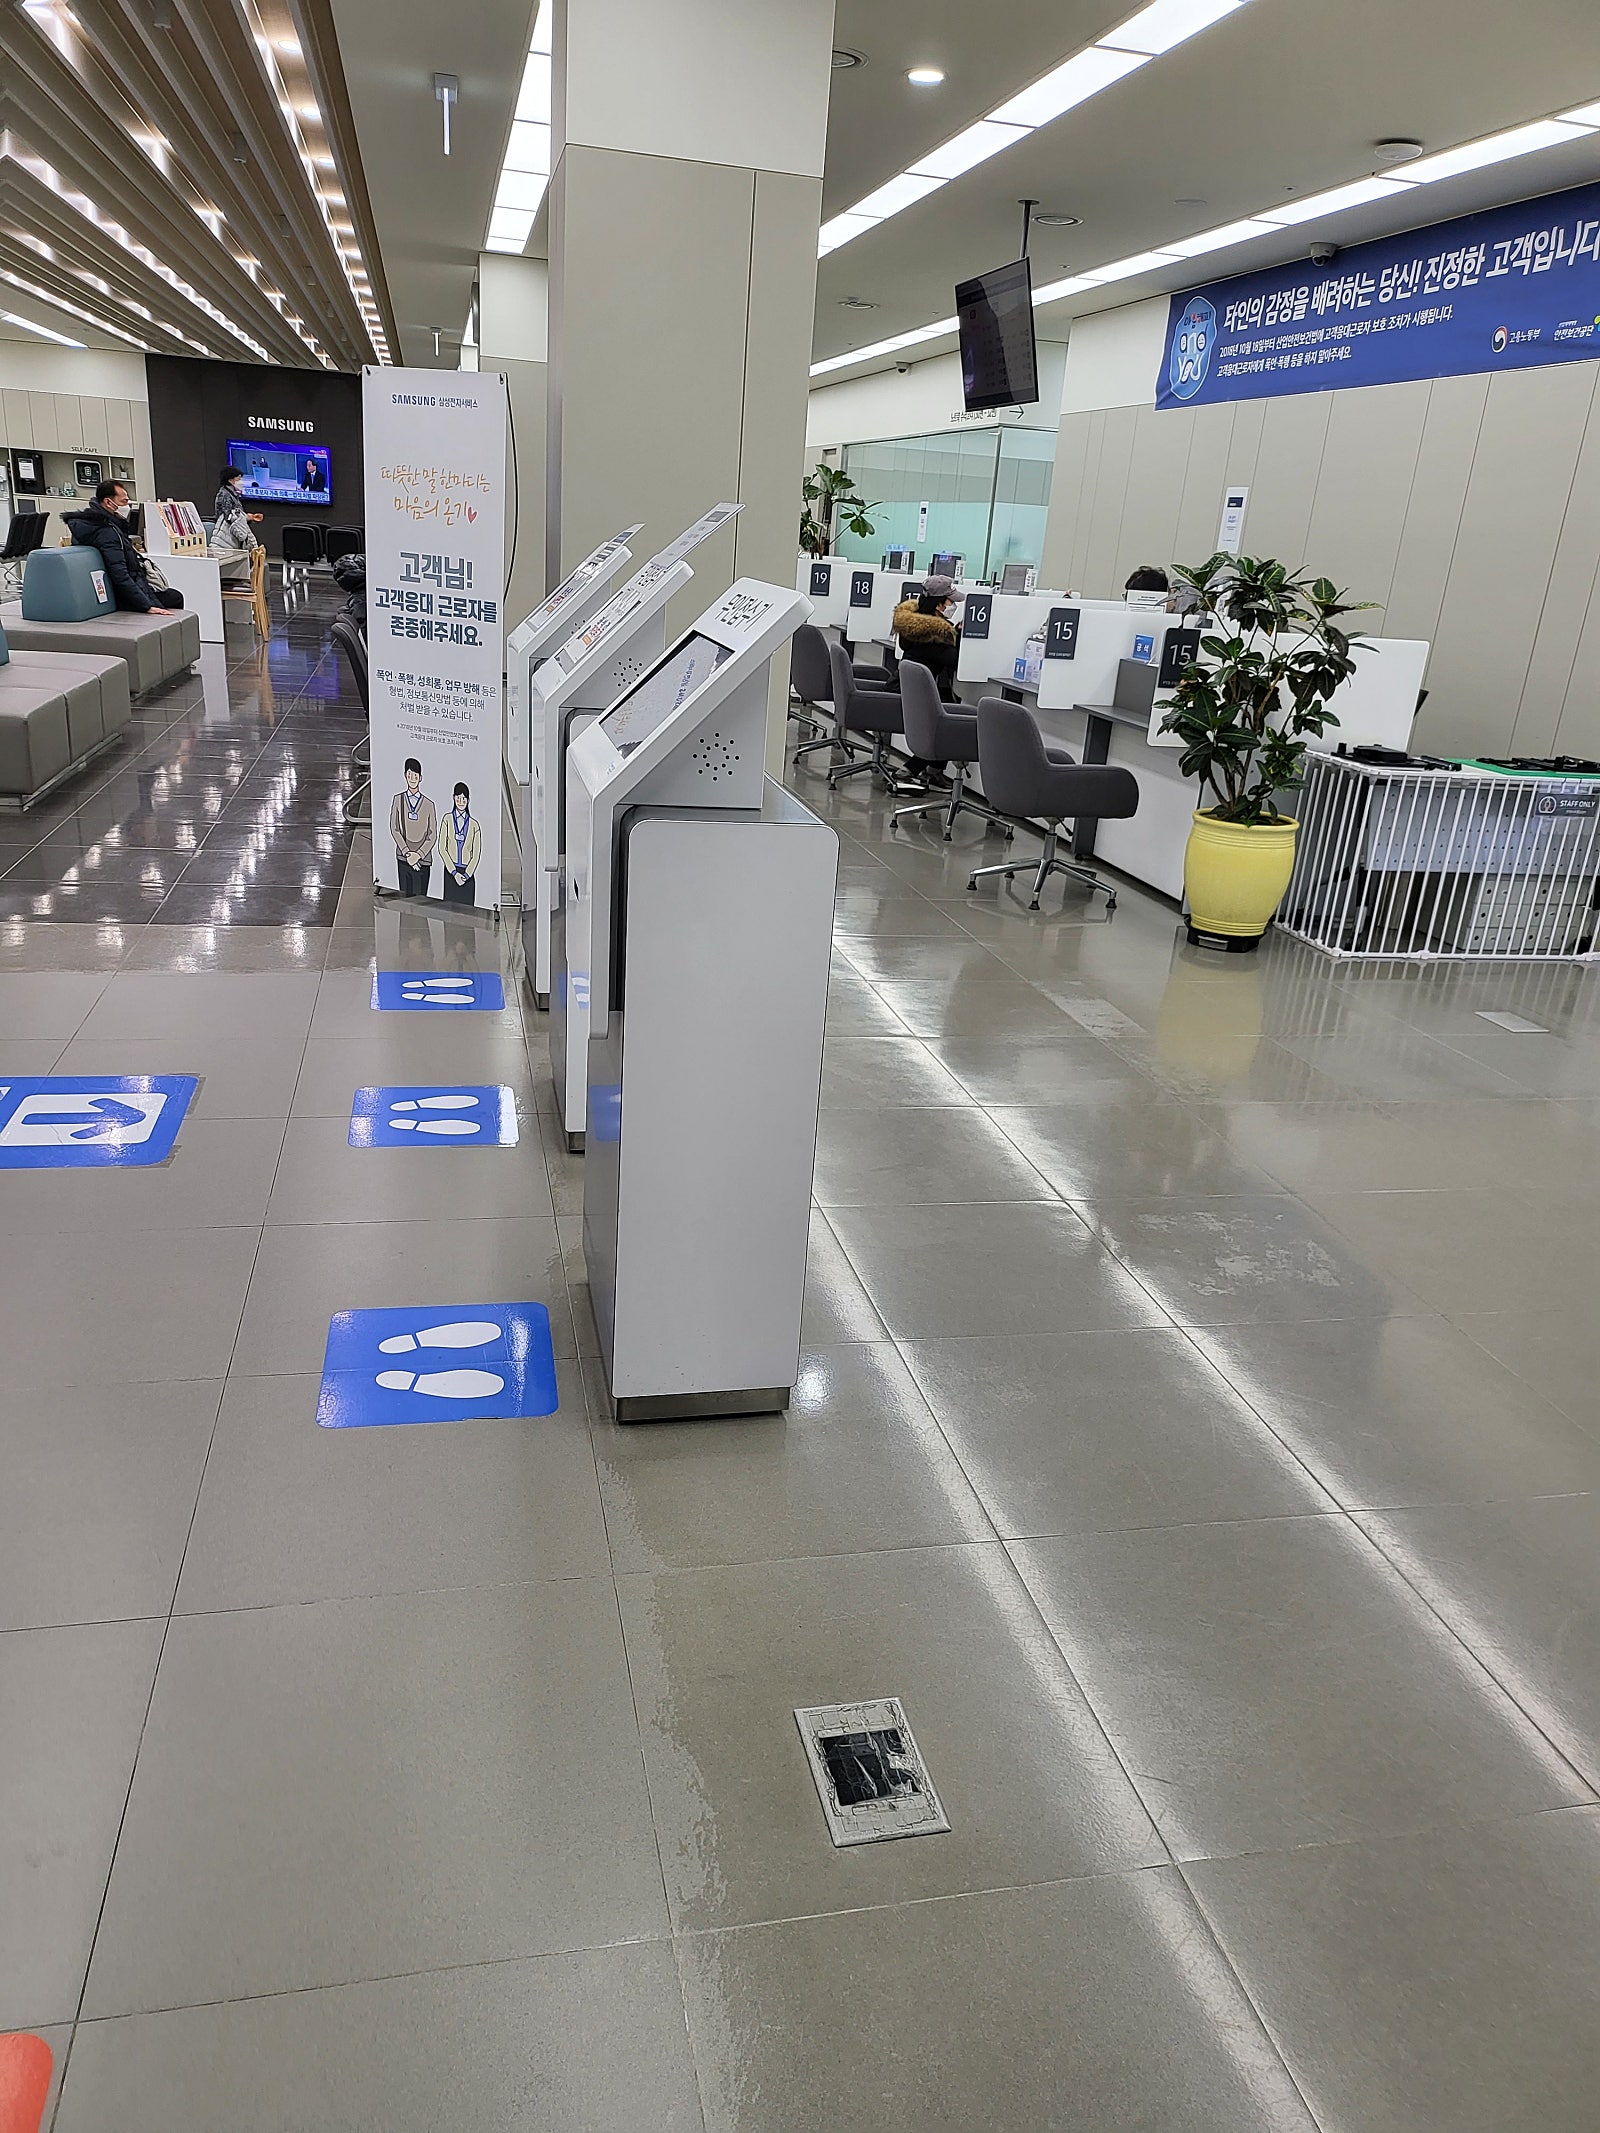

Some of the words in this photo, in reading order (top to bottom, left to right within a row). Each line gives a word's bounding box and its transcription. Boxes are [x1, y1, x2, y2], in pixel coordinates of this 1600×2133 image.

[1223, 294, 1266, 333] 타인의
[1265, 286, 1310, 326] 감정을
[1311, 272, 1376, 316] 배려하는
[1378, 259, 1423, 304] 당신!
[1423, 243, 1486, 295] 진정한
[1219, 343, 1239, 358] 2018년
[1239, 340, 1252, 355] 10월
[1252, 336, 1276, 354] 18일부터
[1323, 320, 1372, 340] 고객응대근로자
[1371, 318, 1387, 333] 보호
[1387, 312, 1412, 330] 조치가
[1412, 304, 1453, 327] 시행됩니다.
[1508, 328, 1541, 344] 고용노동부
[1553, 324, 1595, 341] 안전보건공단
[1216, 358, 1264, 377] 고객응대근로자에게
[1290, 352, 1304, 368] 등을
[1304, 350, 1317, 366] 하지
[391, 393, 436, 406] SAMSUNG
[438, 396, 479, 409] 삼성전자서비스
[247, 416, 314, 433] SAMSUNG
[380, 464, 421, 494] 따뜻한
[422, 467, 438, 494] 말
[394, 495, 440, 520] 마음의
[443, 497, 468, 526] 온기
[399, 551, 473, 591] 고객님!
[814, 571, 828, 584] 19
[855, 580, 870, 595] 18
[375, 587, 434, 615] 고객응대
[438, 595, 498, 624] 근로자를
[714, 593, 774, 632] 무인접수기
[969, 605, 987, 622] 16
[390, 615, 483, 647] 존중해주세요.
[1053, 621, 1074, 641] 15
[1170, 644, 1192, 666] 15
[417, 675, 444, 691] 성희롱,
[445, 679, 462, 692] 업무
[463, 682, 480, 696] 방해
[480, 685, 497, 698] 등은
[388, 685, 406, 698] 형법,
[406, 688, 451, 706] 정보통신망법
[452, 695, 468, 708] 등에
[469, 698, 485, 711] 의해
[399, 701, 415, 714] 처벌
[415, 704, 430, 716] 받을
[431, 707, 441, 717] 수
[441, 708, 474, 723] 있습니다.
[1560, 799, 1579, 807] STAFF
[1578, 800, 1596, 808] ONLY
